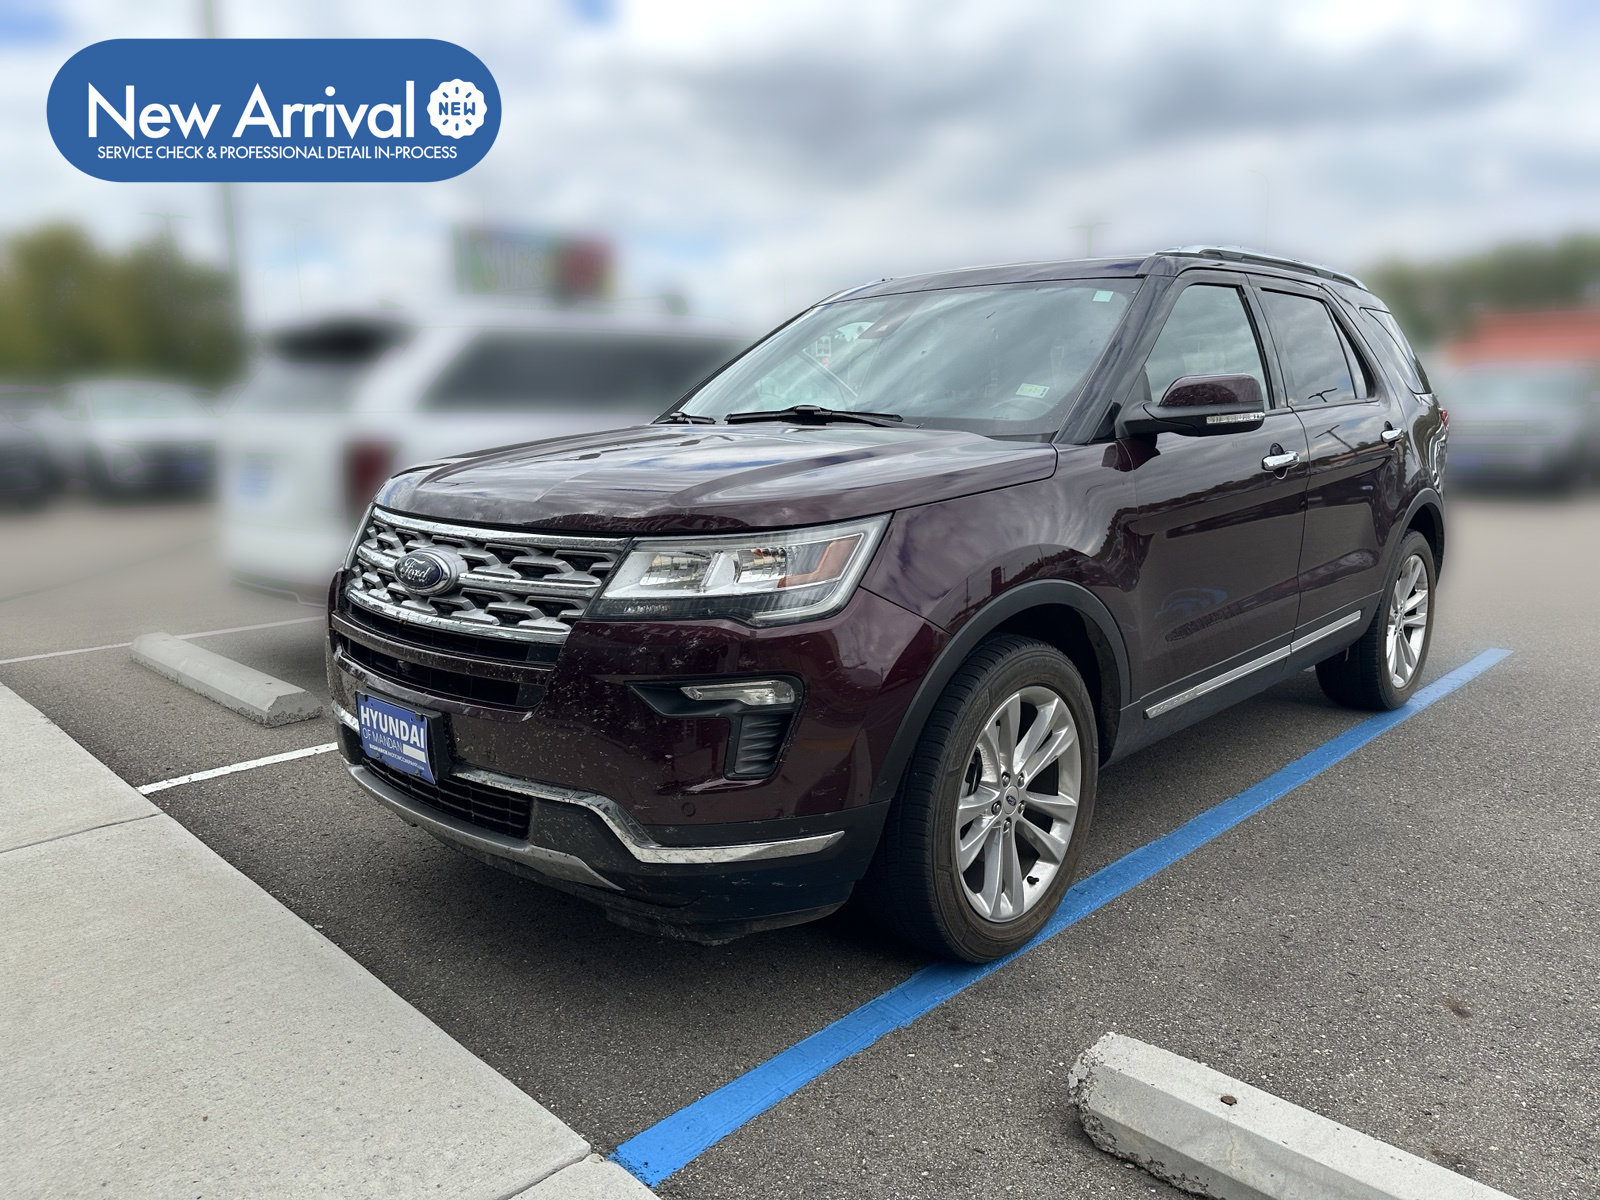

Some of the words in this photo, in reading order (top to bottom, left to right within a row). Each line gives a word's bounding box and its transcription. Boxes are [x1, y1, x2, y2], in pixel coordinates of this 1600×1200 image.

[400, 557, 432, 582] Ford
[360, 704, 425, 749] HYUNDAI
[362, 727, 372, 740] OF
